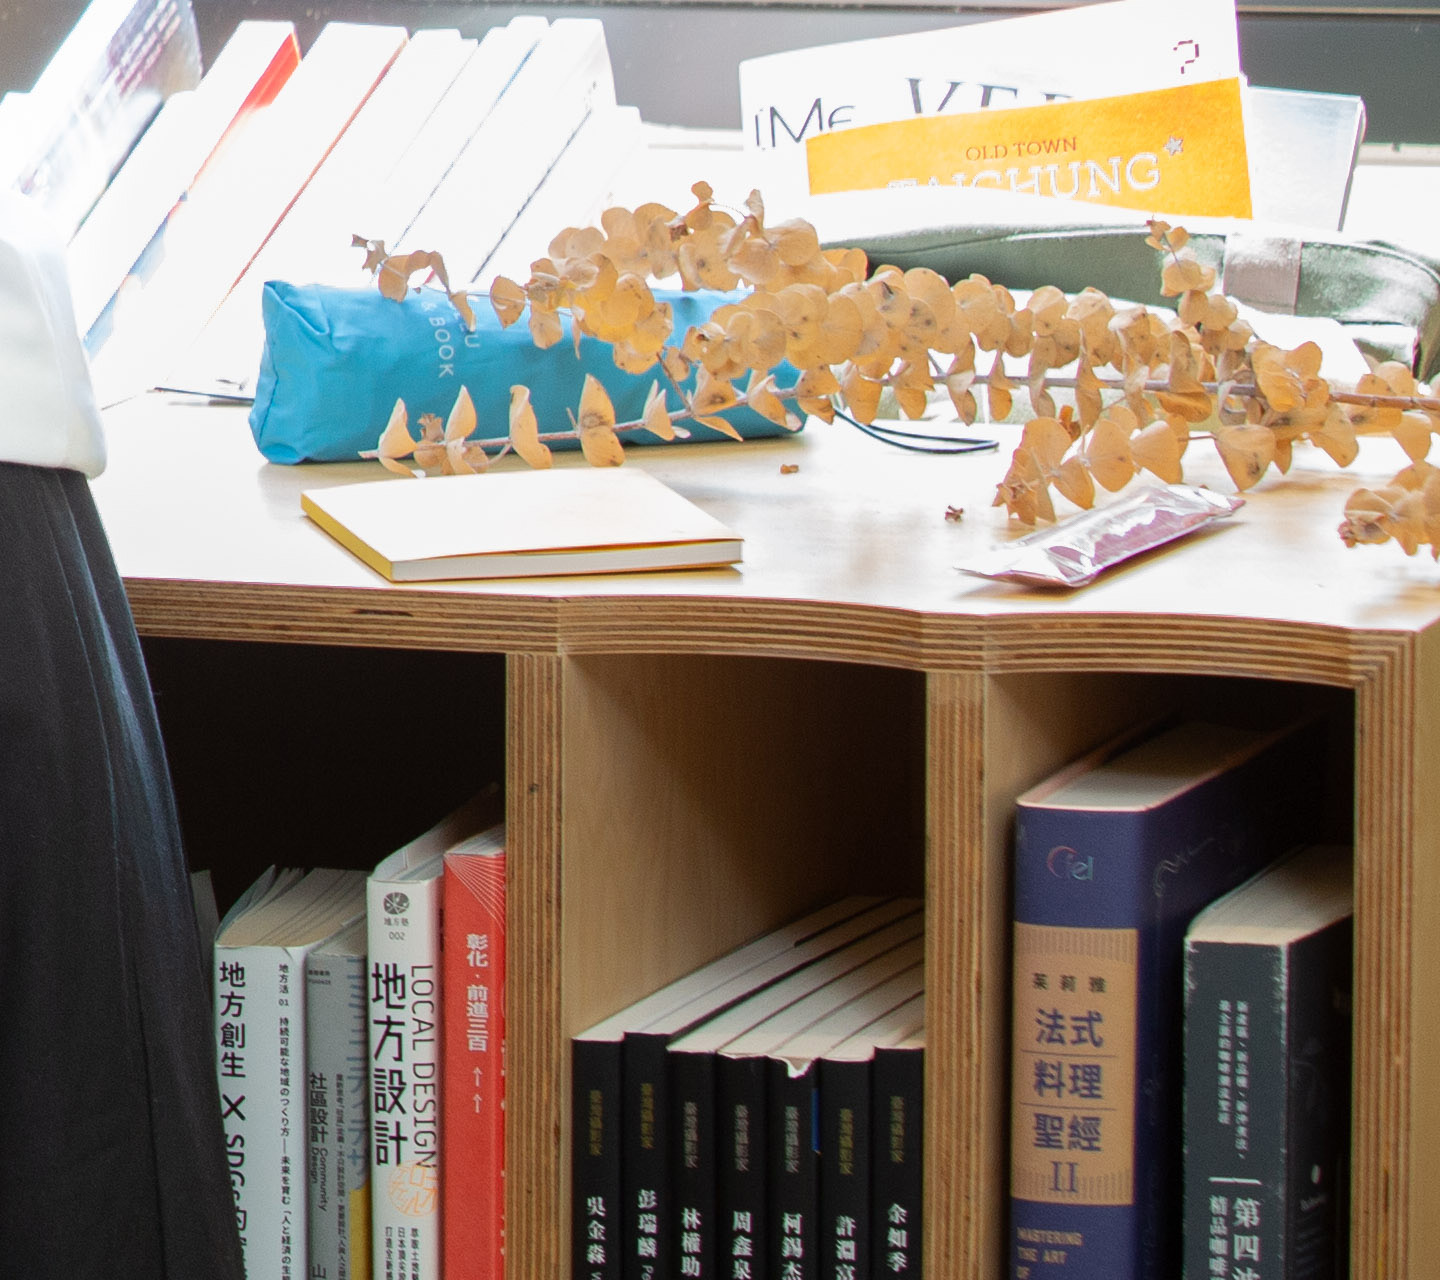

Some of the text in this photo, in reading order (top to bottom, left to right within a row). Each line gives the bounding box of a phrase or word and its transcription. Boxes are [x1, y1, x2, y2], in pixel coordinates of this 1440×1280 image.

[966, 136, 1078, 162] OLD TOWN
[429, 317, 454, 378] BOOK
[389, 931, 405, 940] 002
[219, 961, 246, 1078] 地方創生
[411, 965, 435, 1051] LOCAL
[1035, 1007, 1104, 1048] 法式
[372, 962, 408, 1166] 地方設計
[1033, 1059, 1103, 1099] 料理
[309, 1072, 328, 1143] 社區設計
[413, 1062, 437, 1168] DESIGN
[1033, 1113, 1102, 1152] 聖經
[310, 1147, 330, 1212] Community Design
[1049, 1161, 1079, 1192] II
[1017, 1246, 1067, 1264] THE ART
[1209, 1195, 1228, 1280] 精品咖啡
